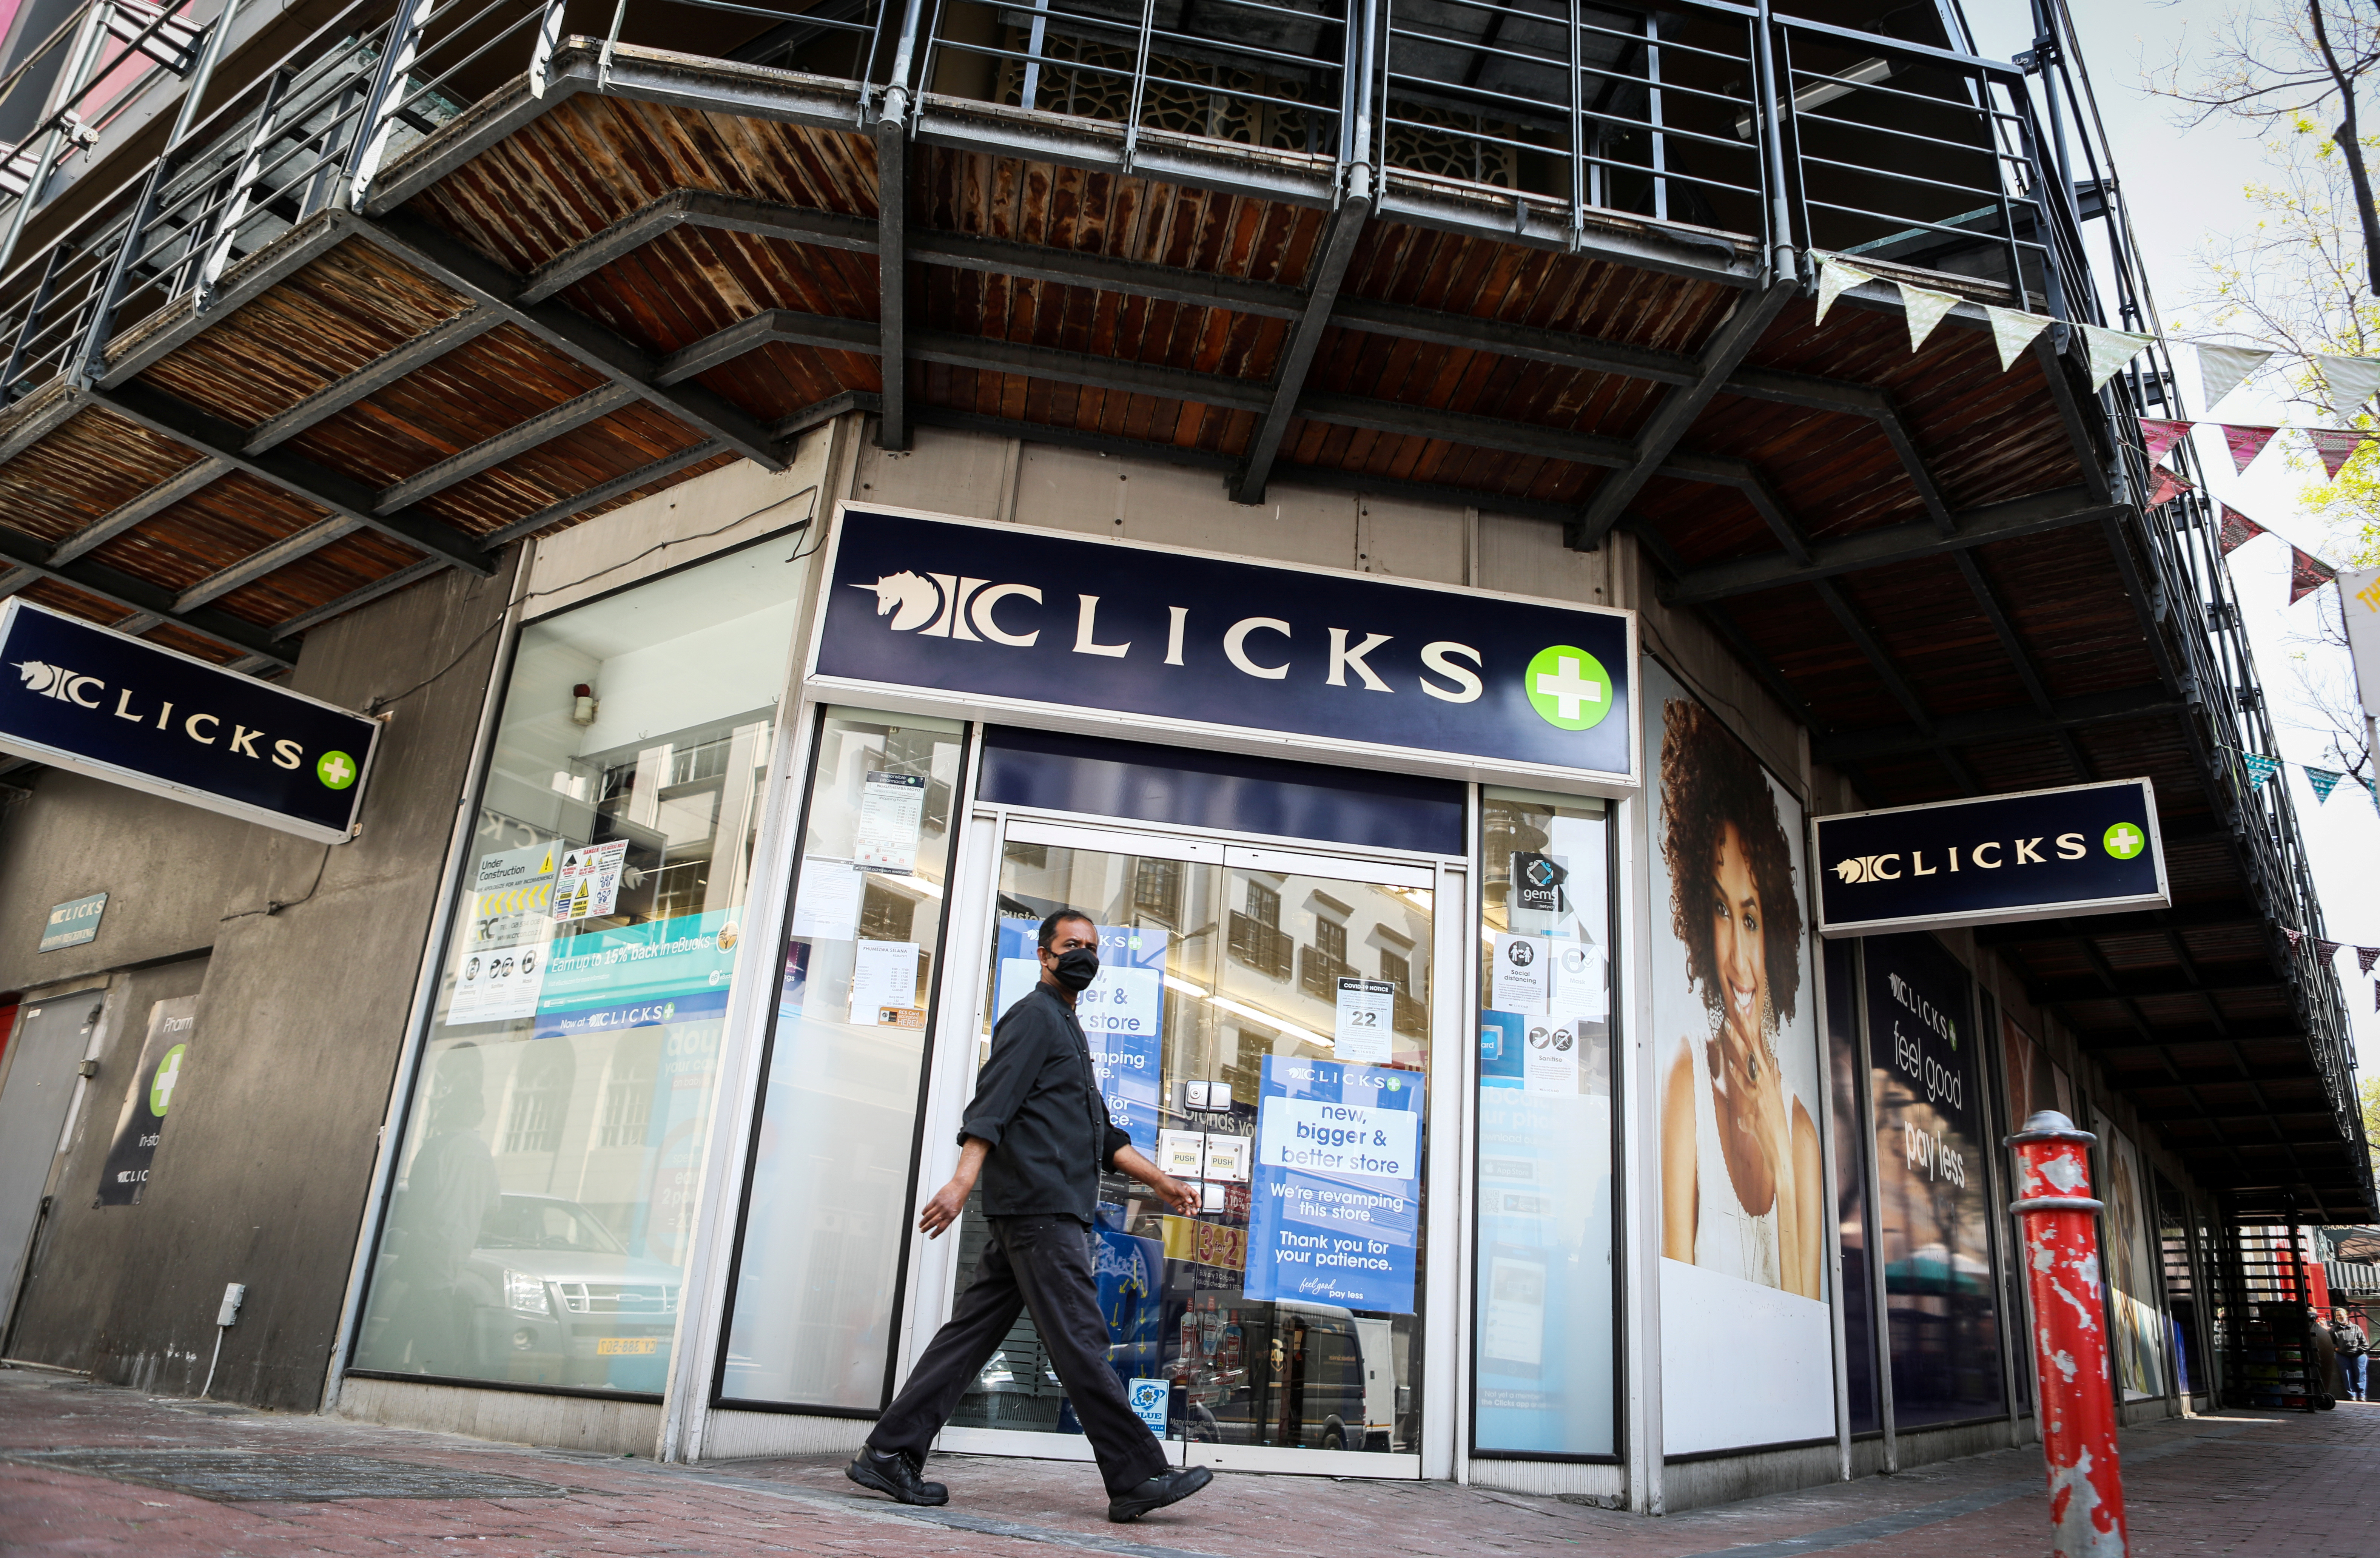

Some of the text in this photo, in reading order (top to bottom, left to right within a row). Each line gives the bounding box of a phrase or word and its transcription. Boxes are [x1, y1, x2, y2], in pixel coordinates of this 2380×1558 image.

[2355, 576, 2380, 612] TH
[971, 583, 1483, 703] CLICKS
[69, 676, 303, 771] CLICKS
[482, 859, 503, 870] Under
[1871, 833, 2086, 880] CLICKS
[479, 865, 525, 881] Construction
[523, 874, 555, 884] INCONVENIENCE
[1523, 889, 1557, 901] gems
[60, 900, 105, 923] CLICKS
[551, 958, 573, 973] Earn
[576, 956, 589, 972] up
[591, 953, 602, 967] to
[630, 942, 658, 961] back
[660, 943, 670, 955] in
[672, 933, 711, 954] eBucks
[1504, 975, 1537, 985] distancing
[1114, 988, 1128, 1004] &
[560, 1005, 663, 1029] Now at CLICKS
[1352, 1011, 1376, 1027] 22
[1899, 981, 1947, 1040] CLICKS
[897, 1019, 919, 1027] HERE!
[1090, 1012, 1141, 1031] store
[1894, 1020, 1962, 1111] feel good
[1304, 1069, 1386, 1089] CLICKS
[1108, 1096, 1130, 1110] for
[1322, 1106, 1367, 1124] new,
[1297, 1121, 1387, 1146] bigger &
[1281, 1145, 1399, 1173] better store
[1904, 1120, 1965, 1188] pay less
[1497, 1167, 1529, 1176] App Store
[1230, 1195, 1245, 1209] 10%
[1270, 1182, 1403, 1212] We're revamping
[1299, 1202, 1374, 1222] this store.
[1199, 1225, 1238, 1266] 3 for 2
[1279, 1230, 1389, 1254] Thank you for
[1275, 1249, 1392, 1271] your patience.
[1210, 1281, 1229, 1290] cheapest
[1219, 1274, 1235, 1282] Colgate
[1299, 1277, 1336, 1295] feel good
[1329, 1290, 1364, 1299] pay less
[1170, 1418, 1184, 1426] Many
